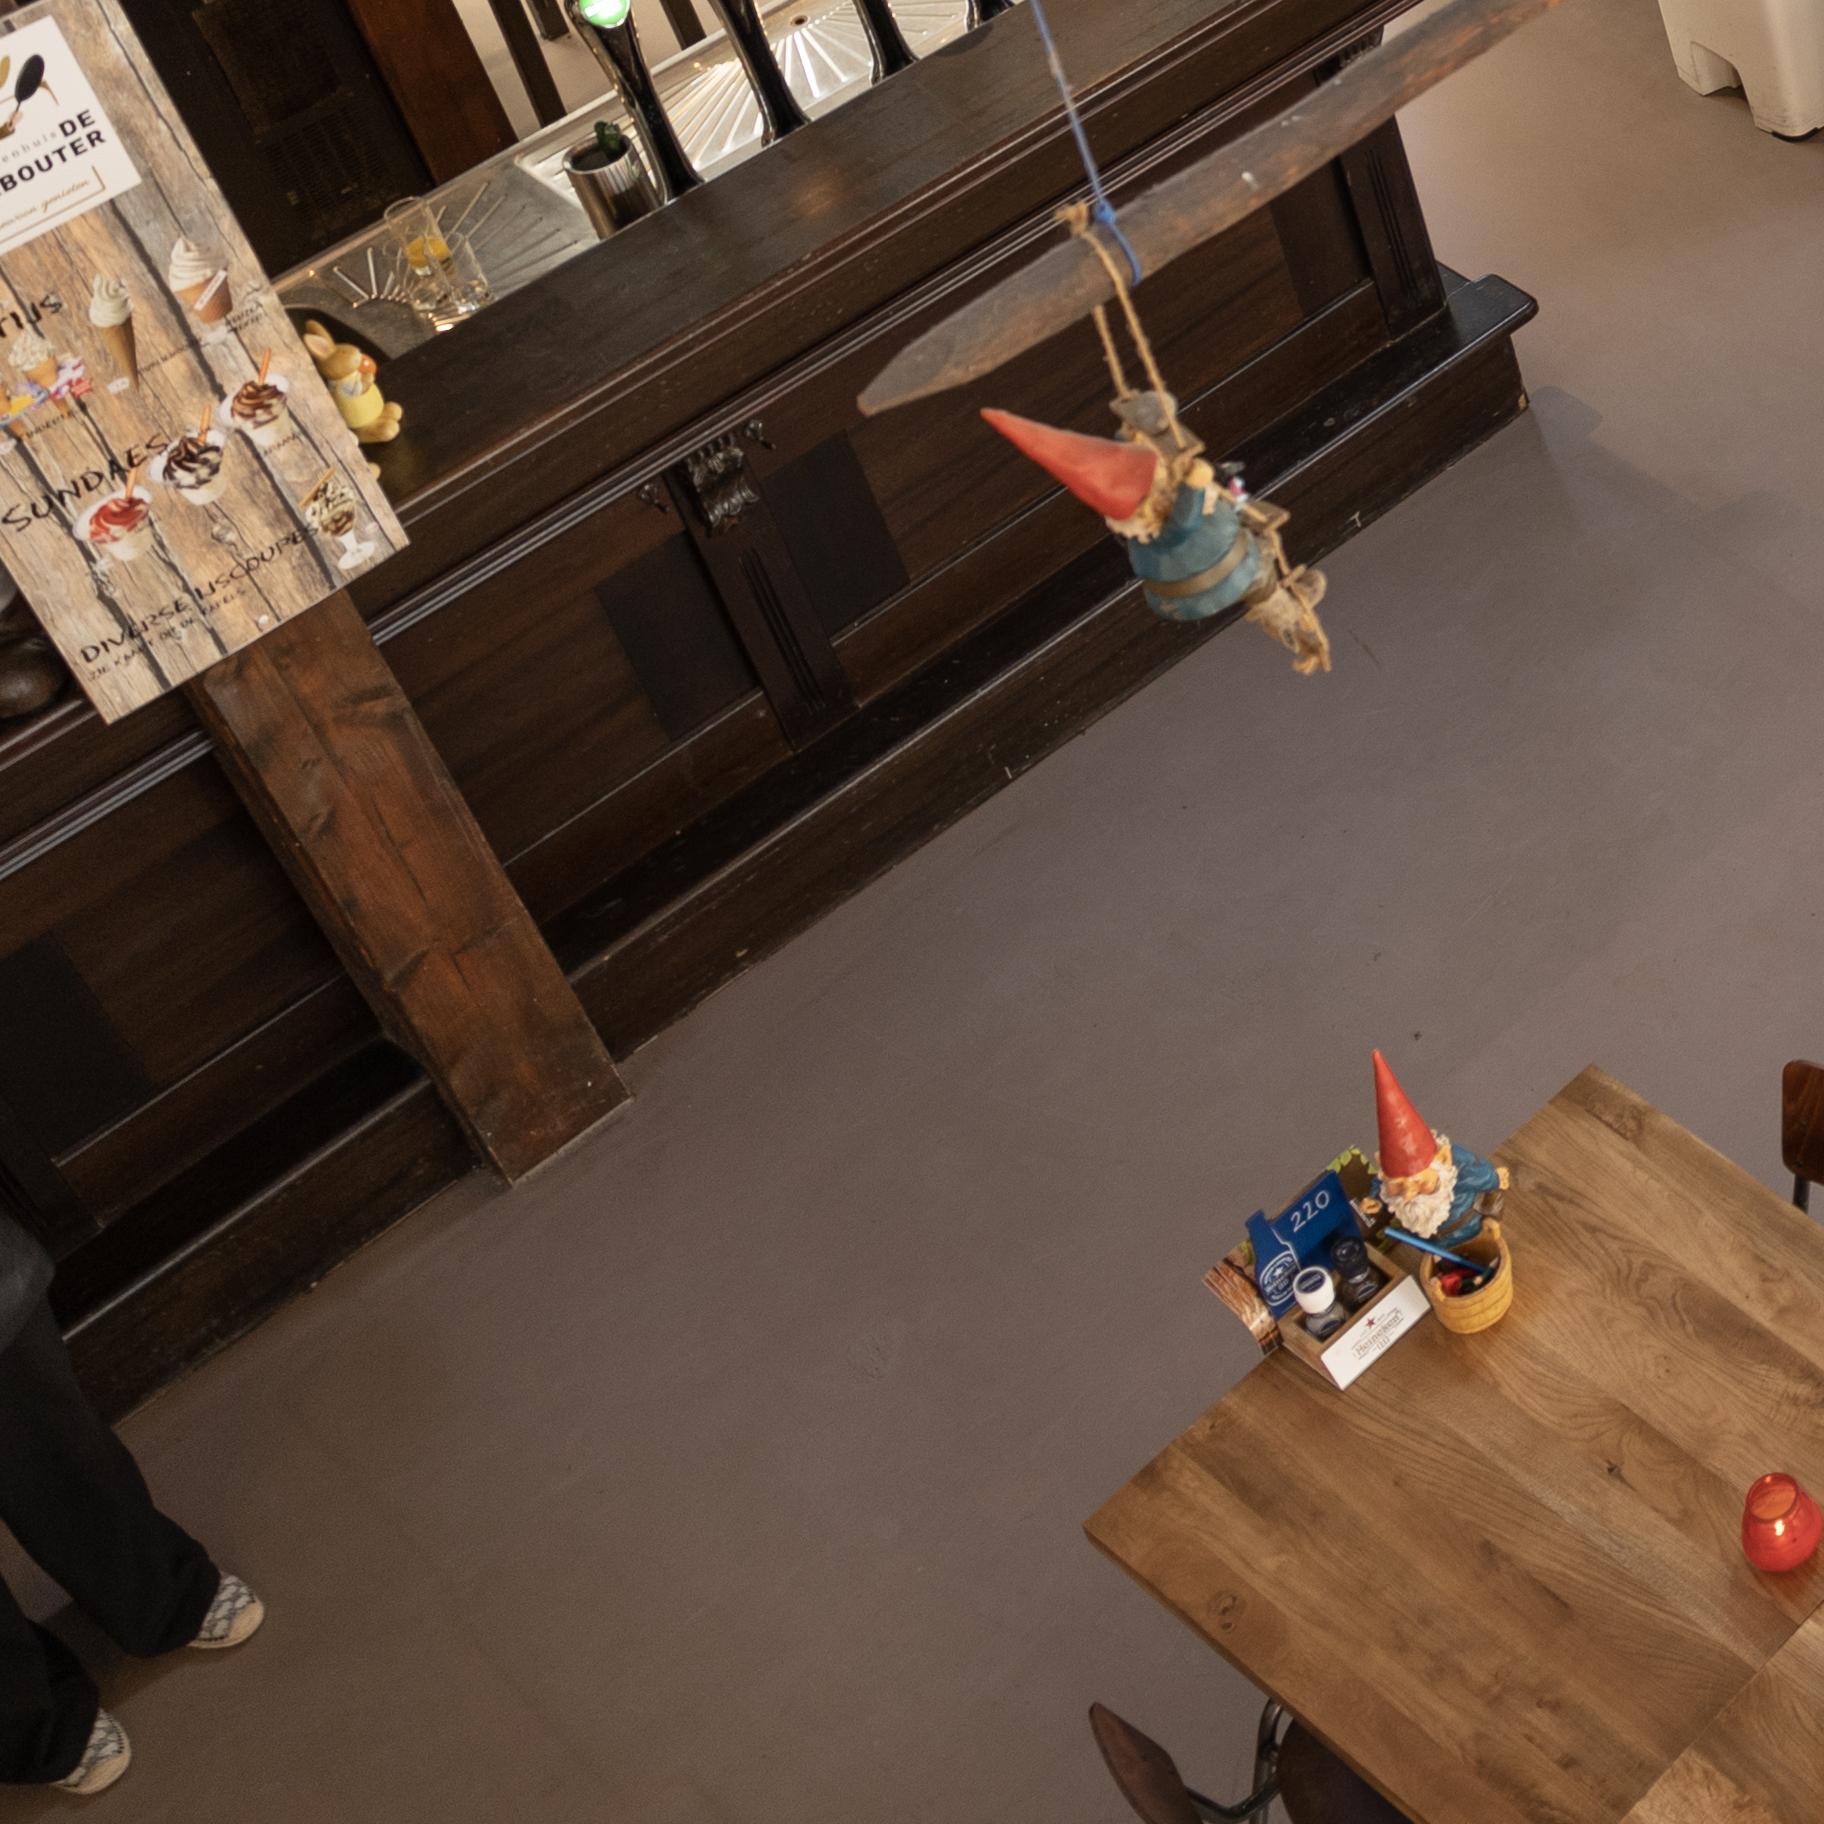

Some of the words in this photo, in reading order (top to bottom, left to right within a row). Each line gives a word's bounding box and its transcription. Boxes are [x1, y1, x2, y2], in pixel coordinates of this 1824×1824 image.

[59, 109, 95, 137] DE
[0, 130, 106, 192] BOUTER
[1, 432, 169, 533] SUNDAES
[80, 596, 191, 664] DIVERSE
[1290, 1190, 1330, 1233] 220
[1355, 1308, 1403, 1356] Heineken
